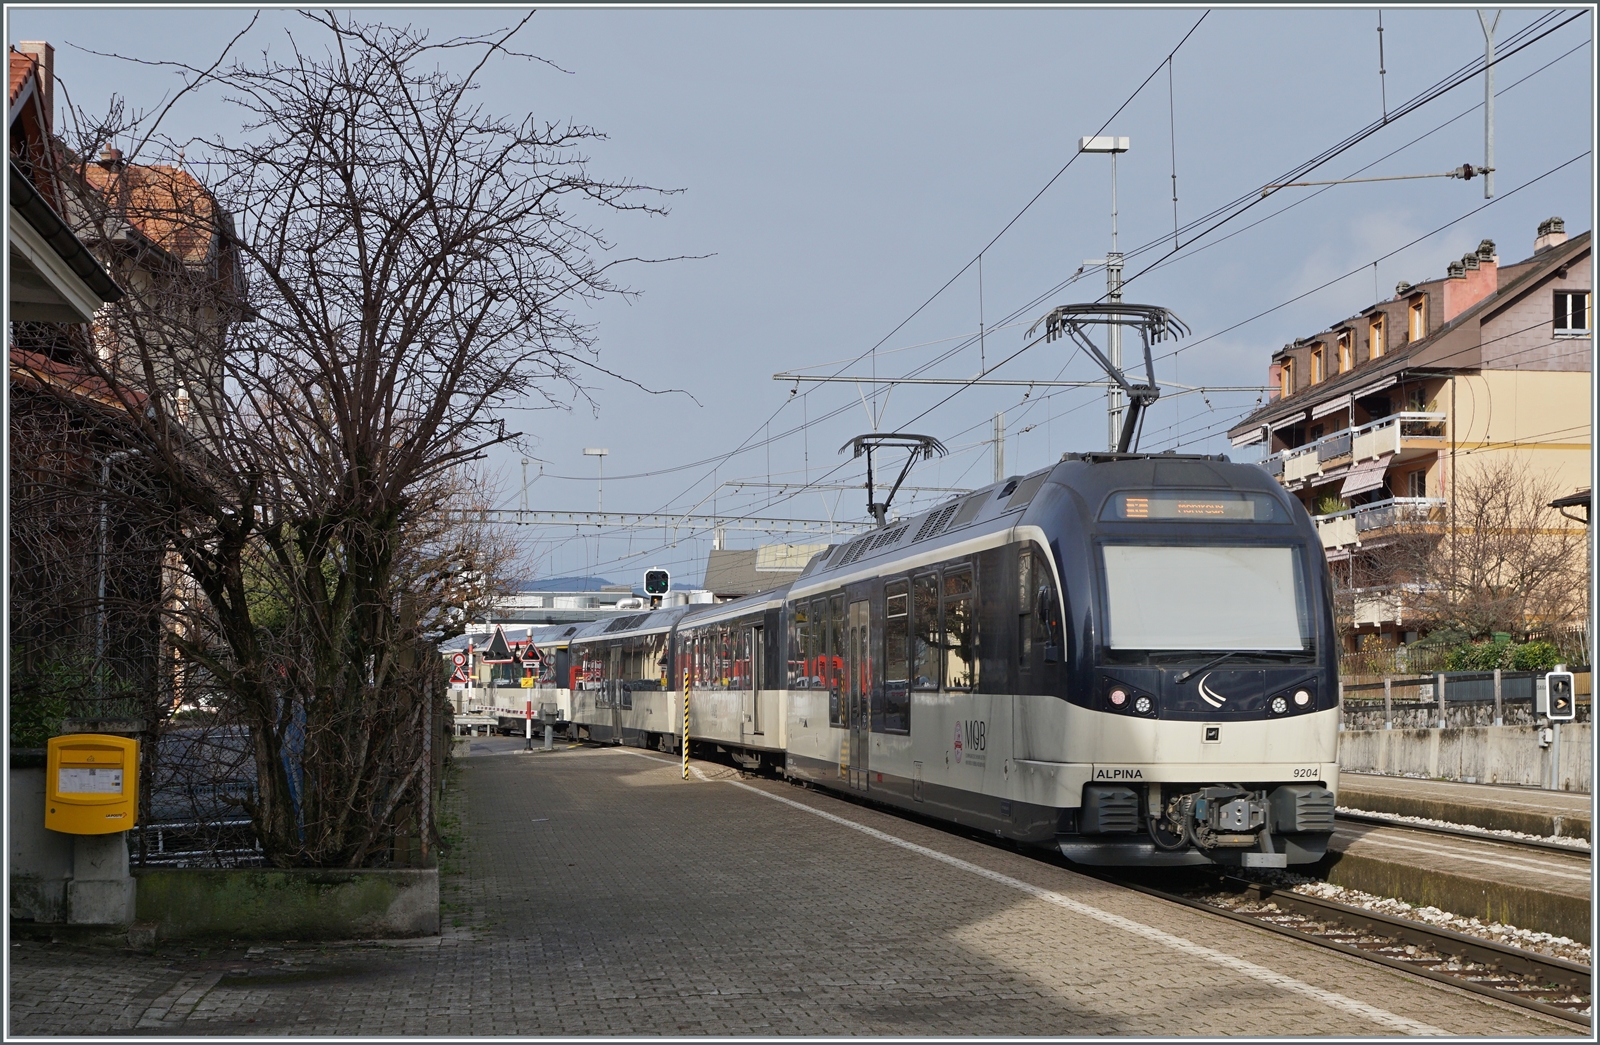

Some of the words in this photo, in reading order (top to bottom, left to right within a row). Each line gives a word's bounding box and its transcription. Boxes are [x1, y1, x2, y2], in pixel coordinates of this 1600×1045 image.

[965, 720, 986, 751] MOB
[1096, 769, 1143, 779] ALPINA
[1293, 768, 1318, 778] 9204
